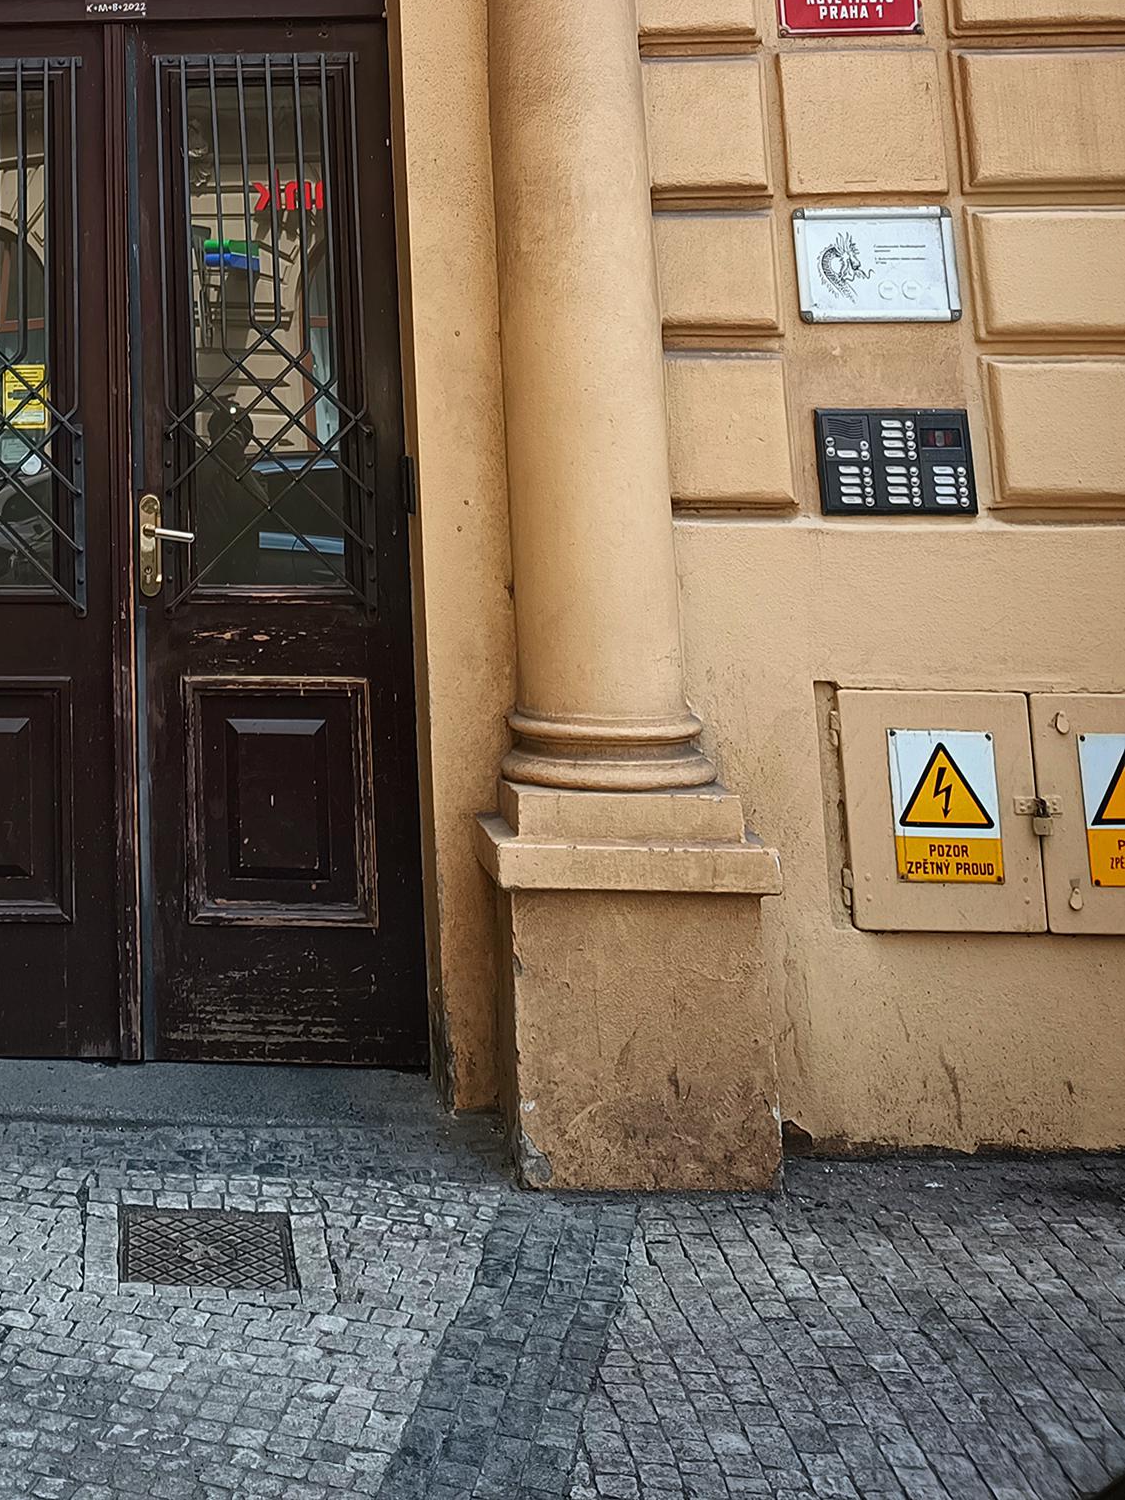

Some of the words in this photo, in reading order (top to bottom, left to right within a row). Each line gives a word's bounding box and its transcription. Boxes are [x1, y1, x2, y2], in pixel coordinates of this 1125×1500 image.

[819, 5, 869, 20] PRAHA
[875, 4, 884, 18] 1
[929, 843, 969, 858] POZOR
[907, 858, 951, 875] ZPĚTNÝ
[955, 861, 994, 876] PROUD
